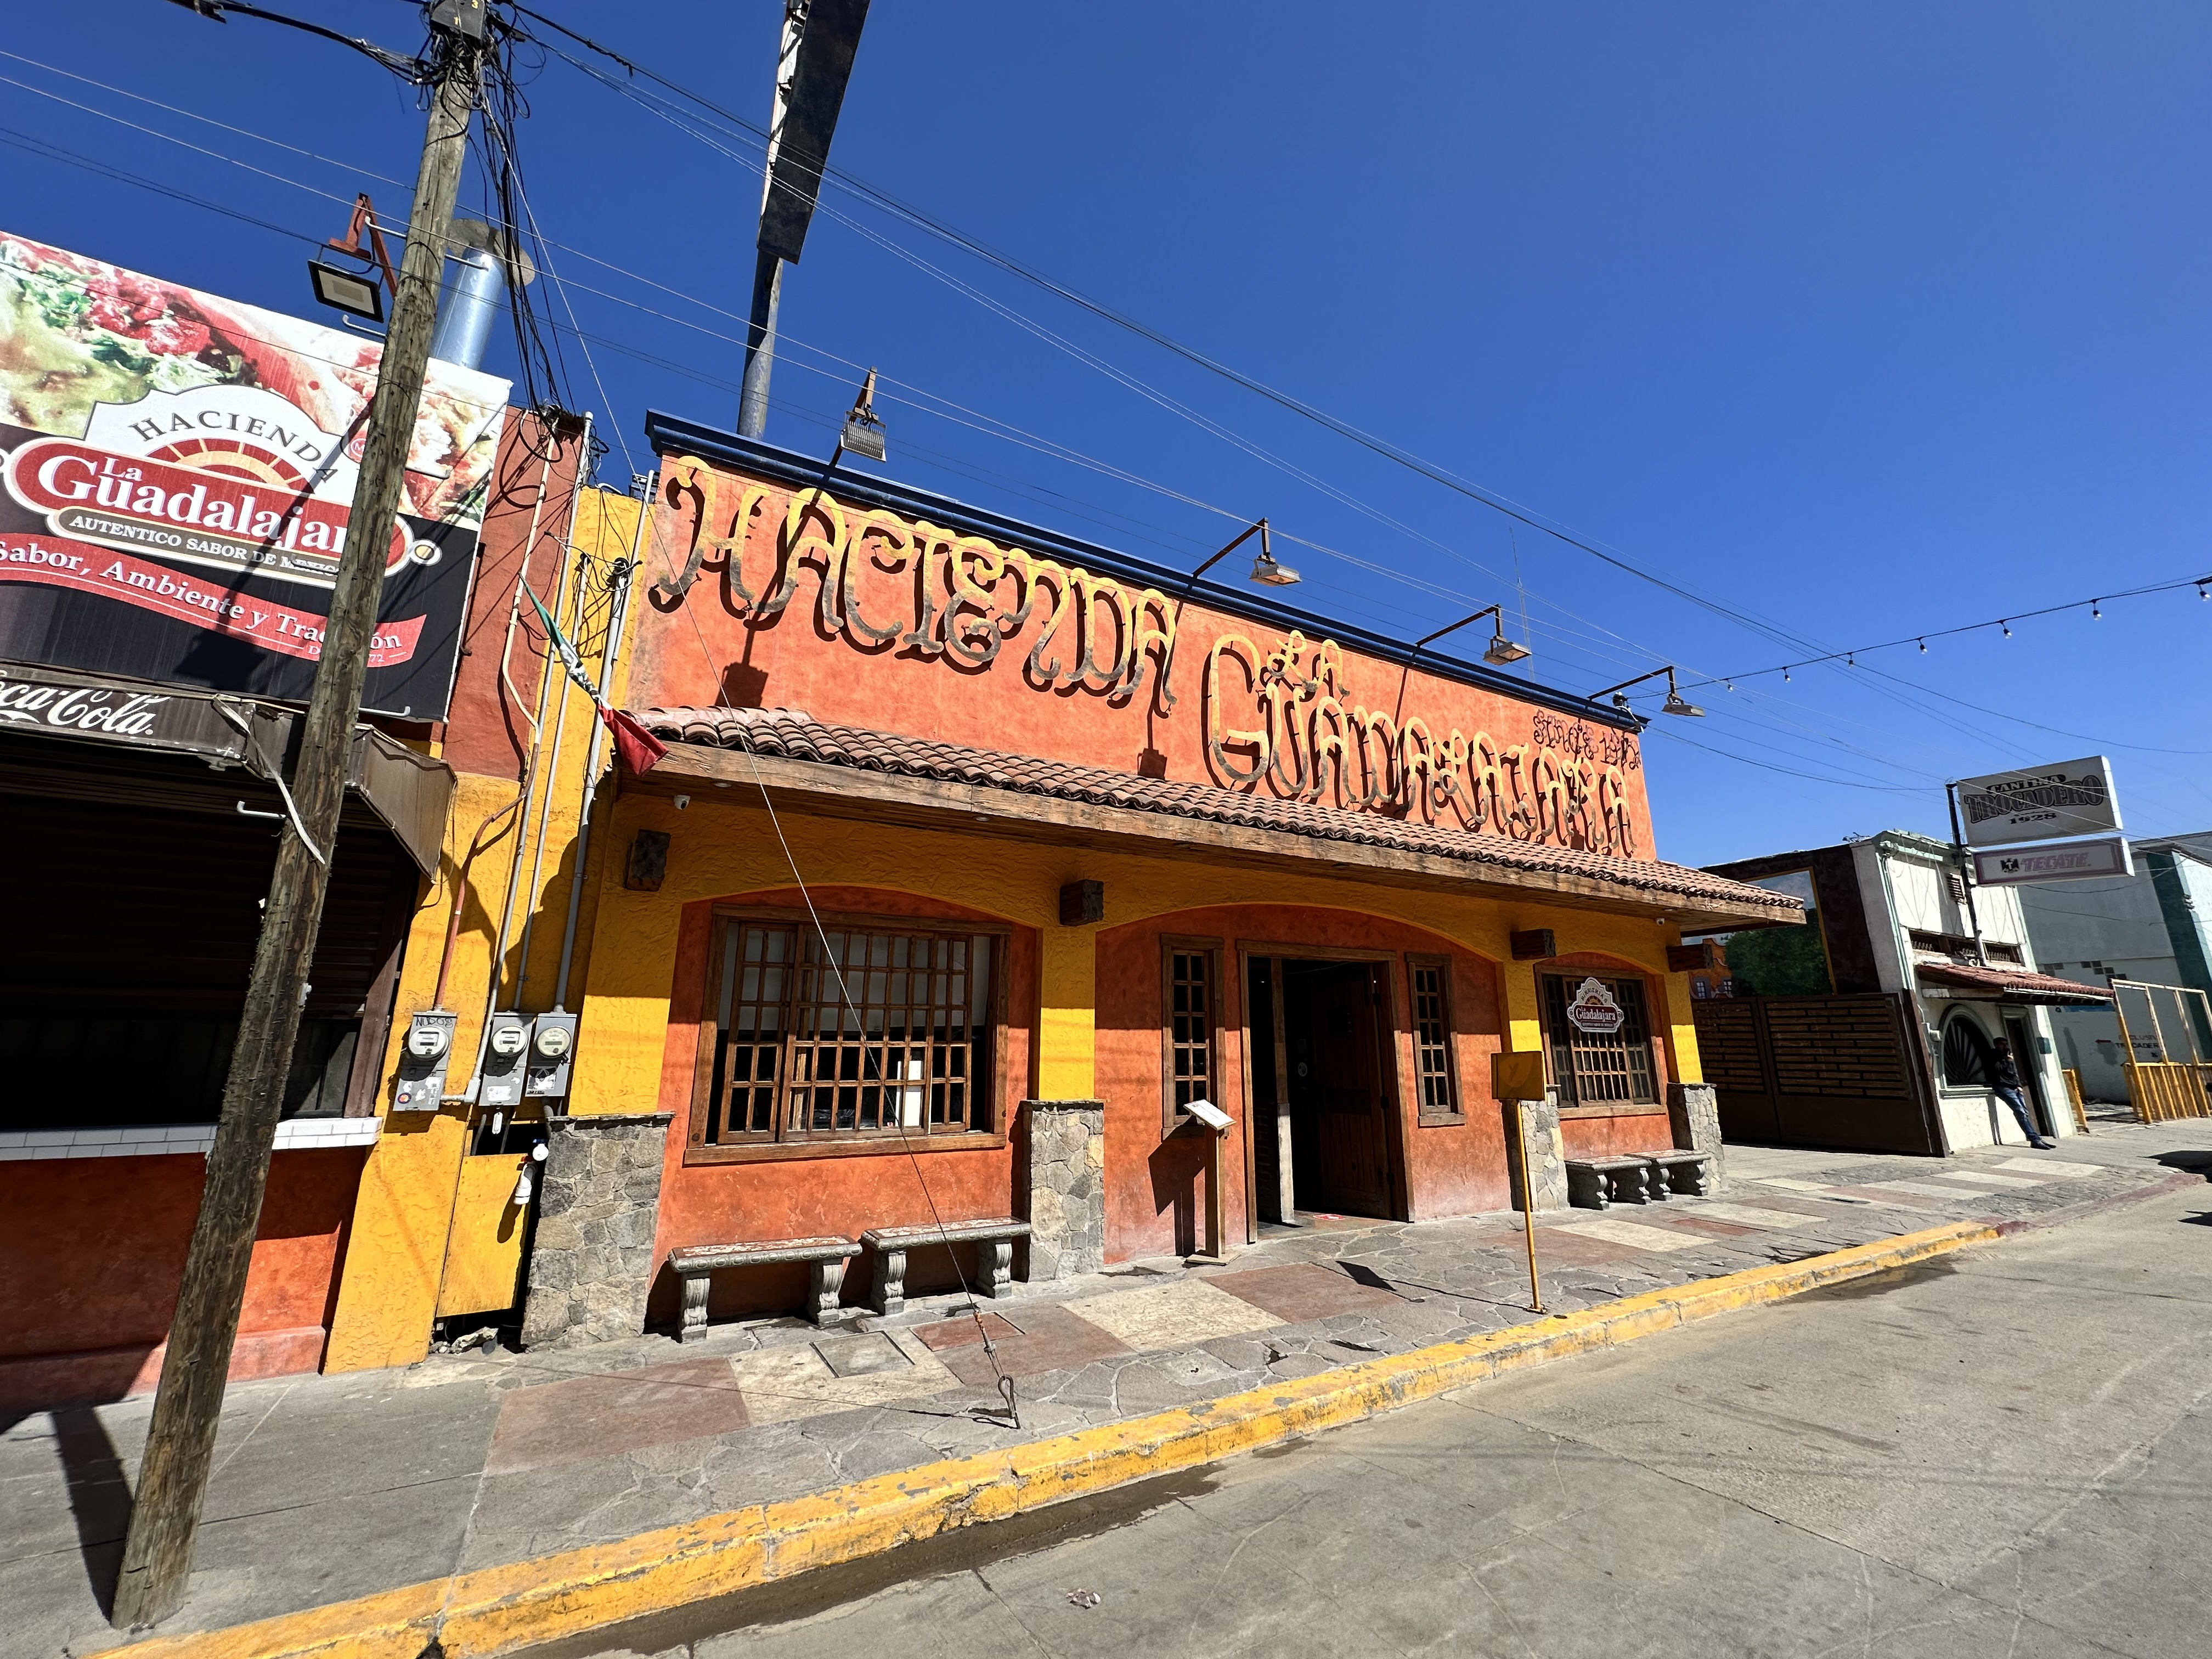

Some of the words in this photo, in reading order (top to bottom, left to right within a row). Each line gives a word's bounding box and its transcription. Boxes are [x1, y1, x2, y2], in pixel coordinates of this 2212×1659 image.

[100, 456, 143, 481] La
[128, 410, 338, 483] HACIENDA
[38, 455, 347, 554] Guadalajar
[69, 515, 182, 547] AUTENTICO
[186, 538, 247, 560] SABOR
[252, 550, 277, 565] DE
[0, 541, 91, 576] Sabor,
[99, 561, 245, 619] Ambiente
[245, 610, 269, 630] y
[657, 455, 1177, 706] HACIENDA
[1267, 629, 1351, 697] LA
[1211, 633, 1638, 850] GUADALAJARA
[1964, 775, 2104, 824] TROCADERO
[2009, 812, 2057, 825] 1928
[2021, 851, 2089, 872] TECATE
[1576, 1008, 1617, 1022] Guadalajara
